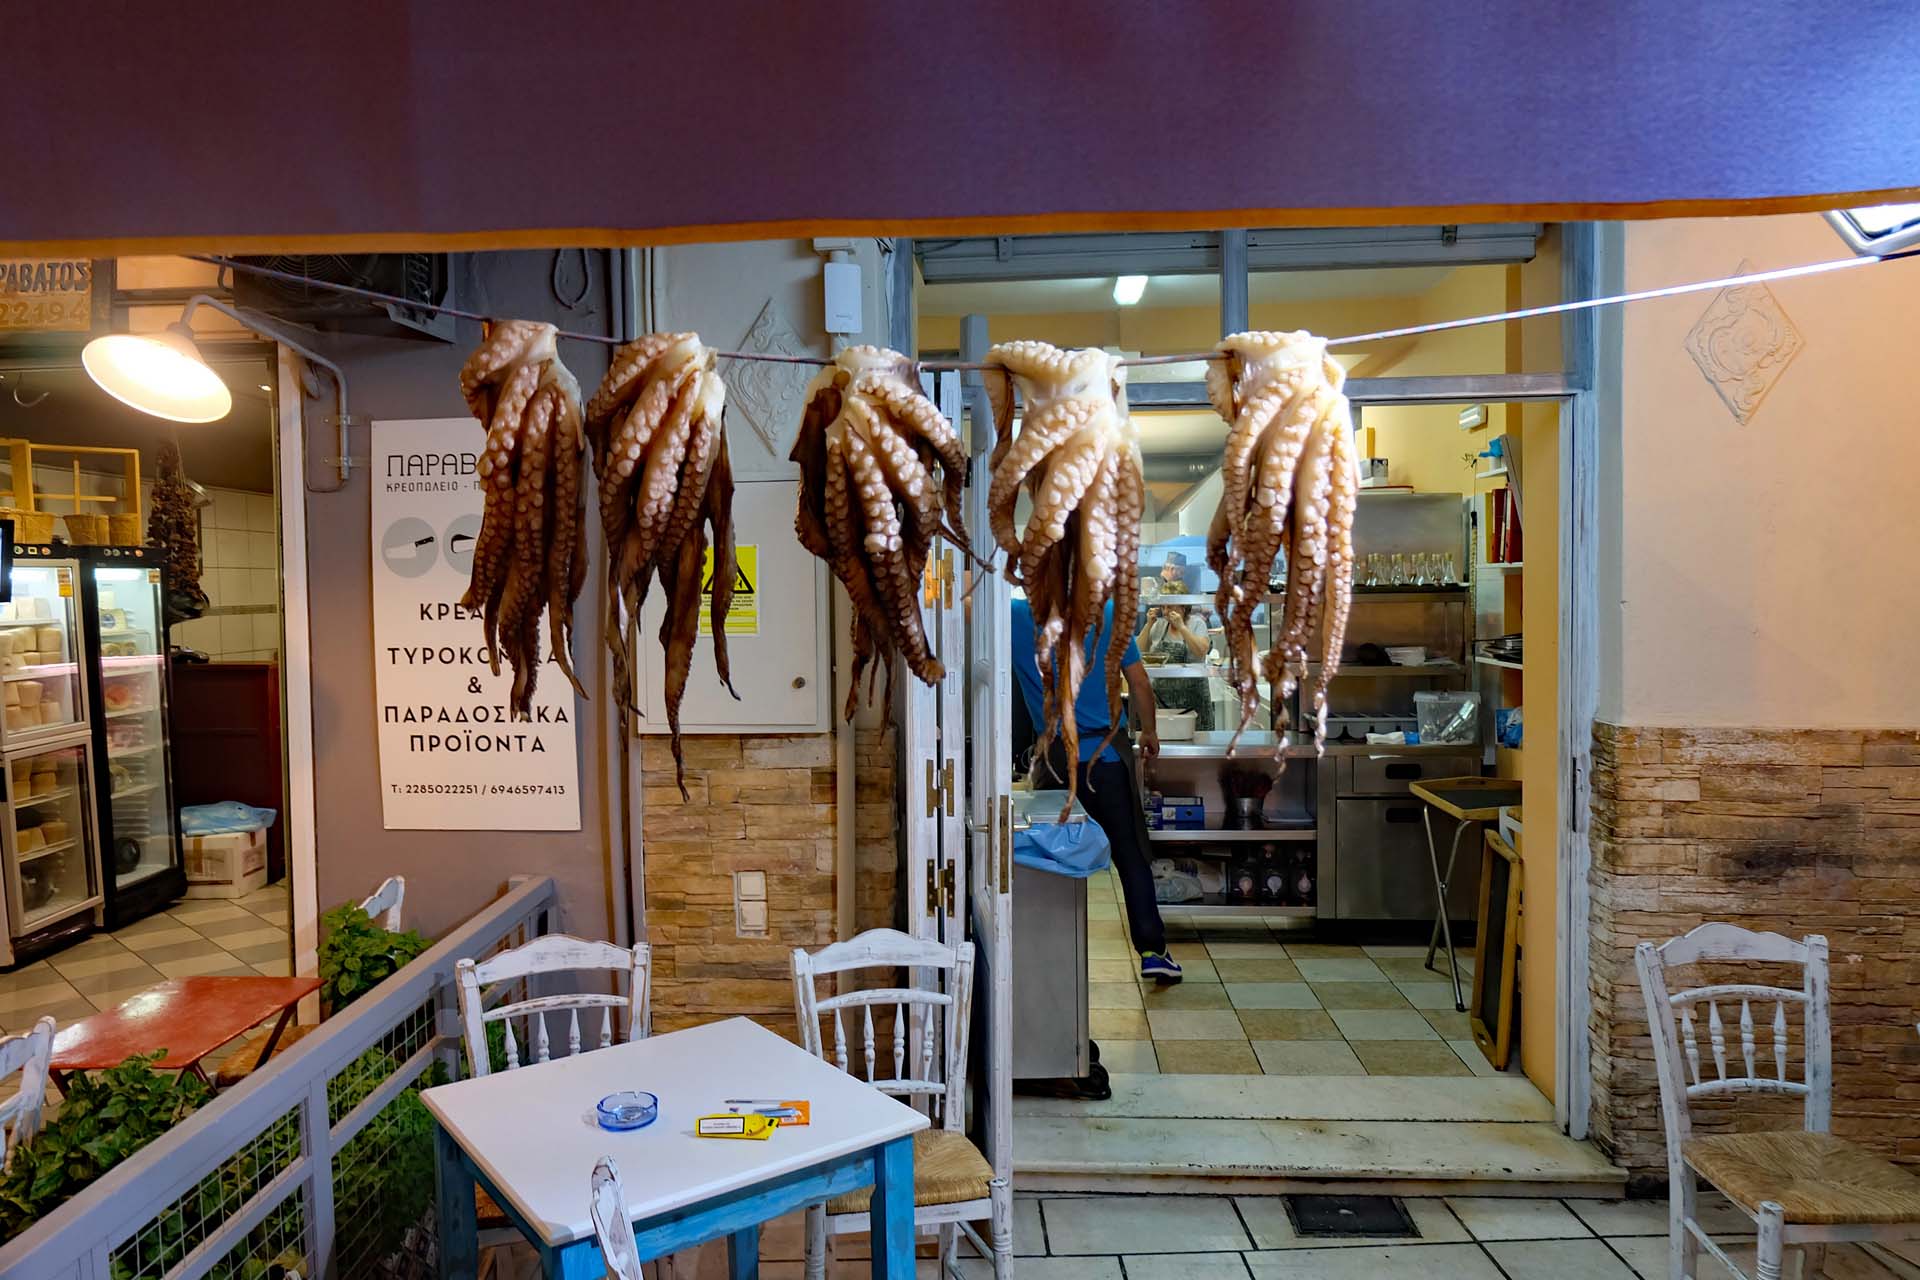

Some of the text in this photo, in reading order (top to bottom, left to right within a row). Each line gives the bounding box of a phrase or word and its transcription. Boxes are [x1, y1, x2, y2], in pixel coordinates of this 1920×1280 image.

[386, 481, 458, 492] ΚΡΕΟΠΩΛΕΙΟ
[467, 676, 482, 694] &
[410, 729, 546, 752] ΠΡΟΪΟΝΤΑ
[405, 784, 478, 794] 2285022251
[490, 785, 565, 795] 6946597413
